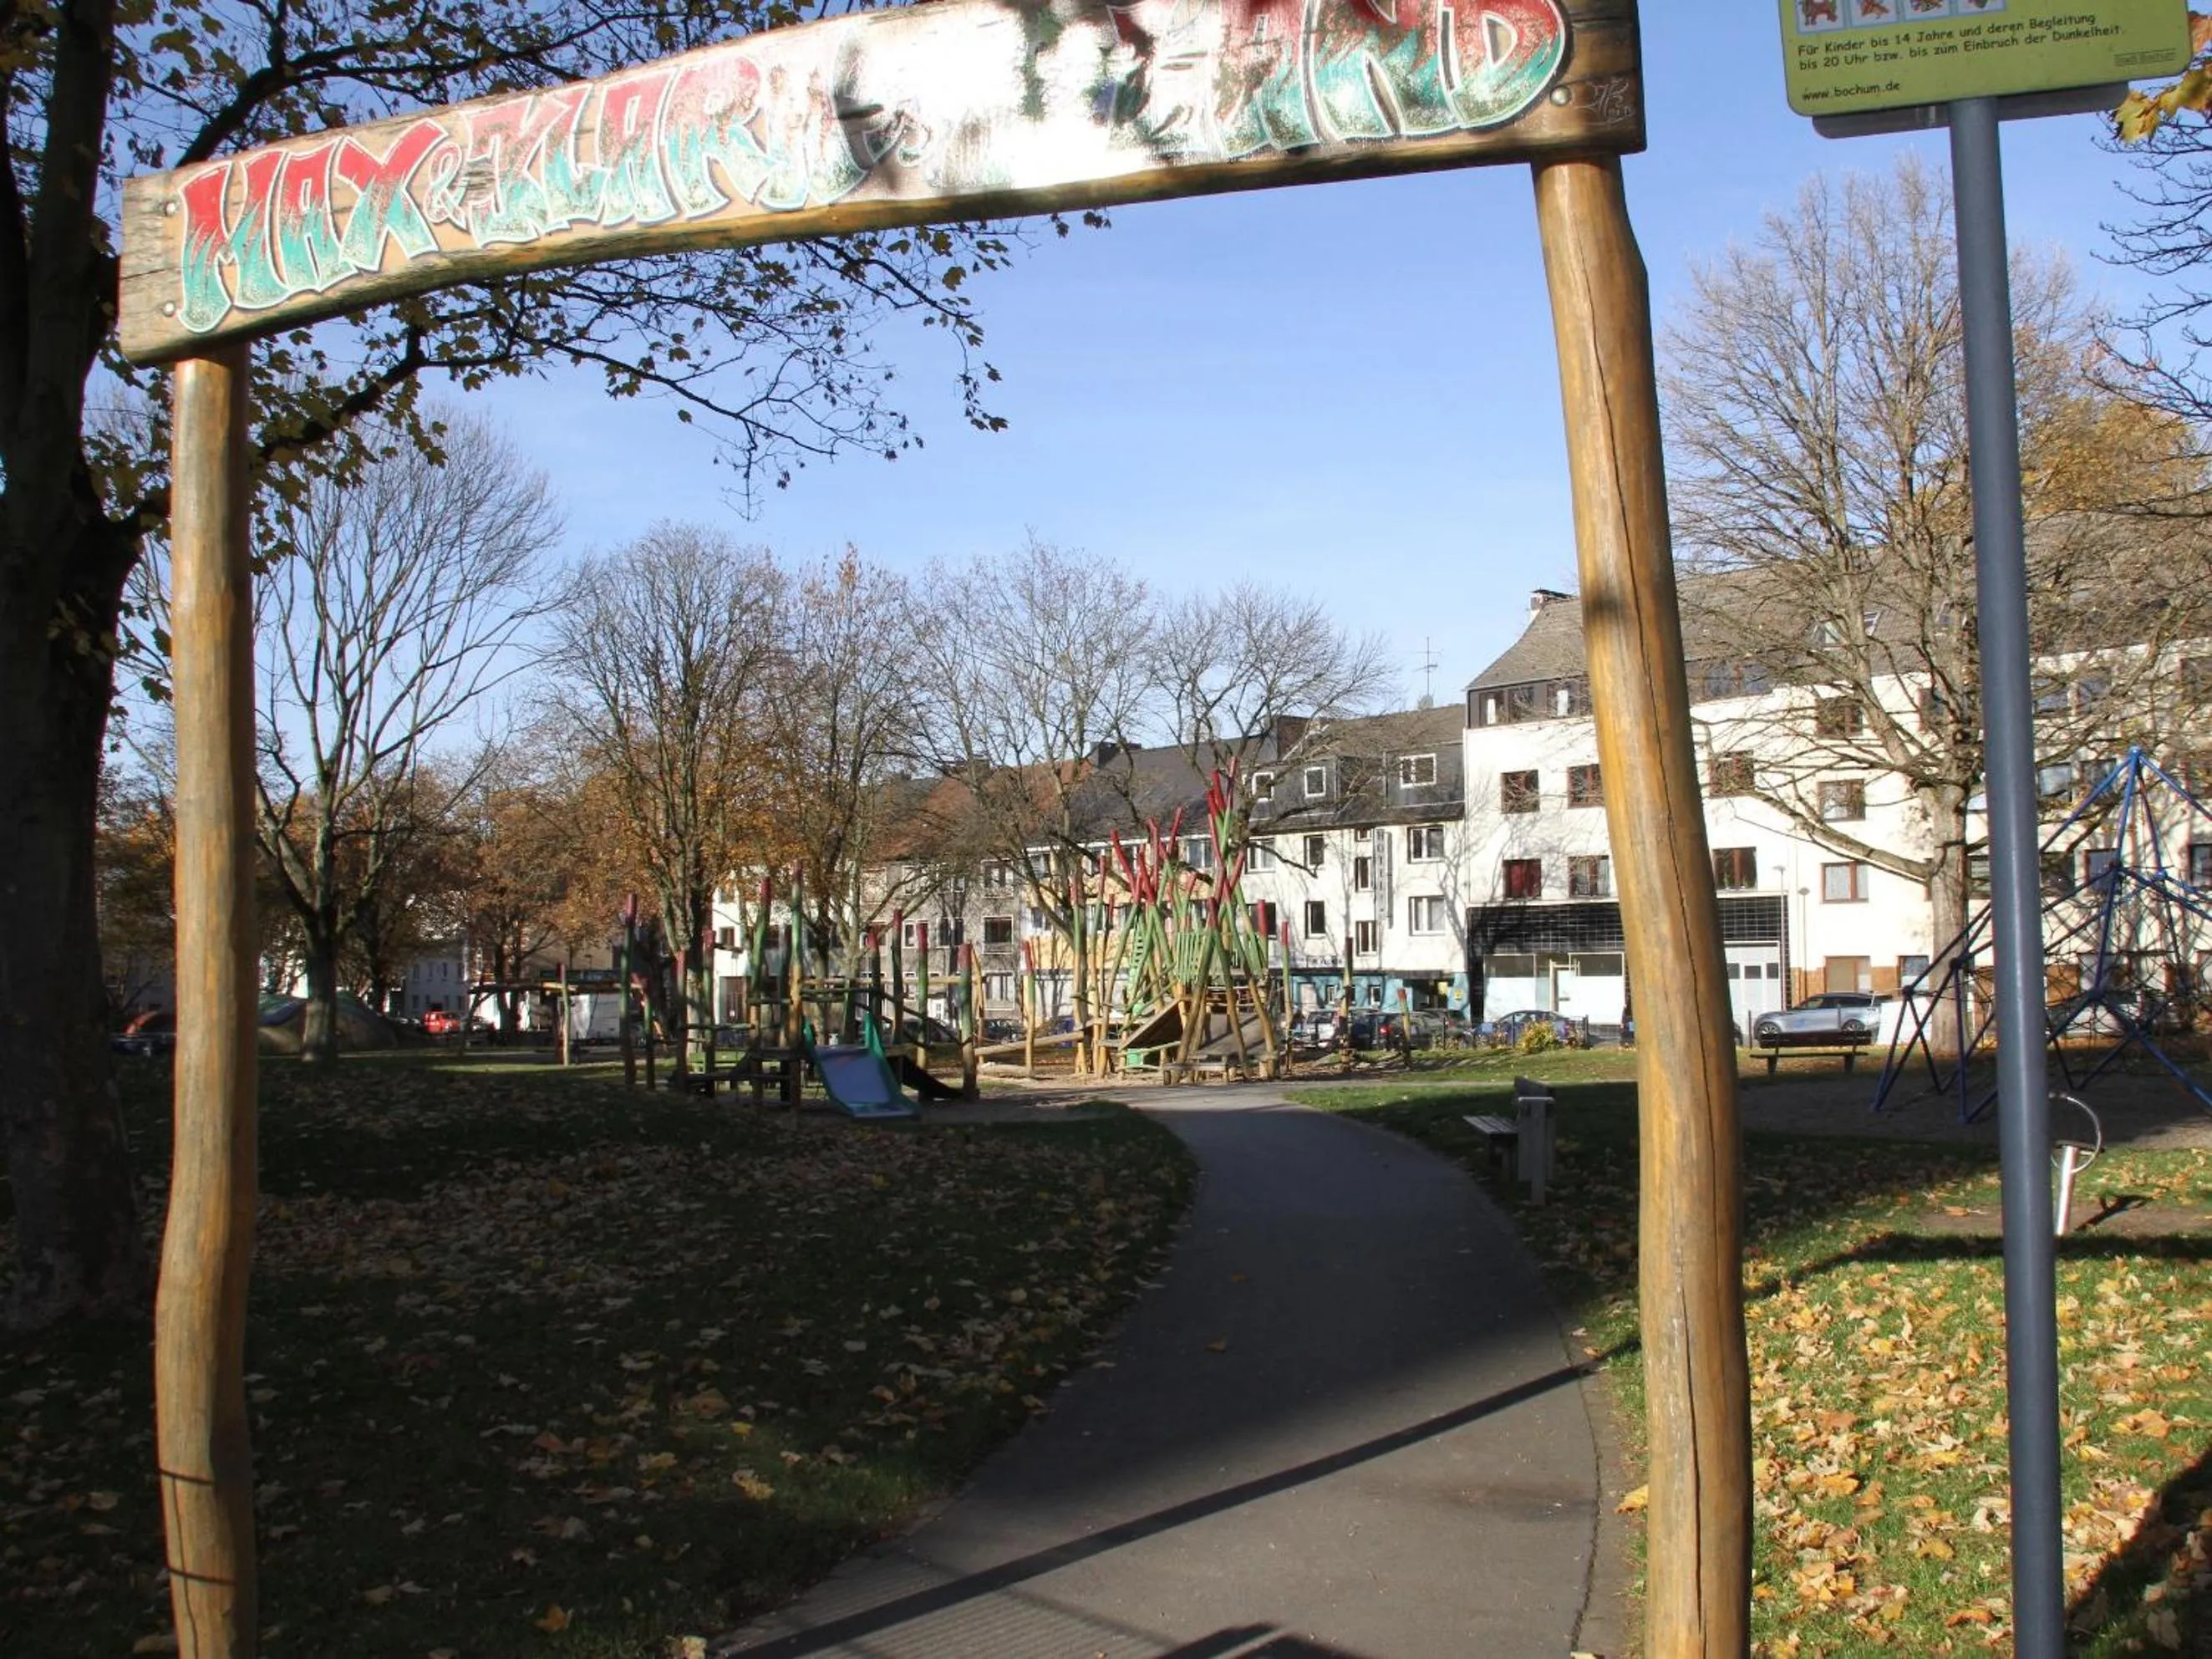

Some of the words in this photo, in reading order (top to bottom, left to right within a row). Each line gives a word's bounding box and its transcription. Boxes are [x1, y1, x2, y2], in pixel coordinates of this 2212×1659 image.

[1798, 44, 1819, 57] Für
[1824, 40, 1865, 53] Kinder
[1870, 37, 1889, 48] bis
[1894, 33, 1911, 45] 14
[1916, 30, 1955, 43] Jahre
[1959, 24, 1981, 37] und
[1987, 22, 2024, 34] deren
[2028, 14, 2096, 31] Begleitung
[1799, 60, 1818, 70] bis
[1823, 56, 1839, 67] 20
[1843, 53, 1869, 65] Uhr
[1874, 51, 1904, 63] bzw.
[1909, 47, 1929, 59] bis
[1933, 44, 1959, 56] zum
[1963, 36, 2019, 53] Einbruch
[2024, 33, 2047, 44] der
[1802, 80, 1901, 101] www.bochum.de
[176, 119, 448, 333] MAX
